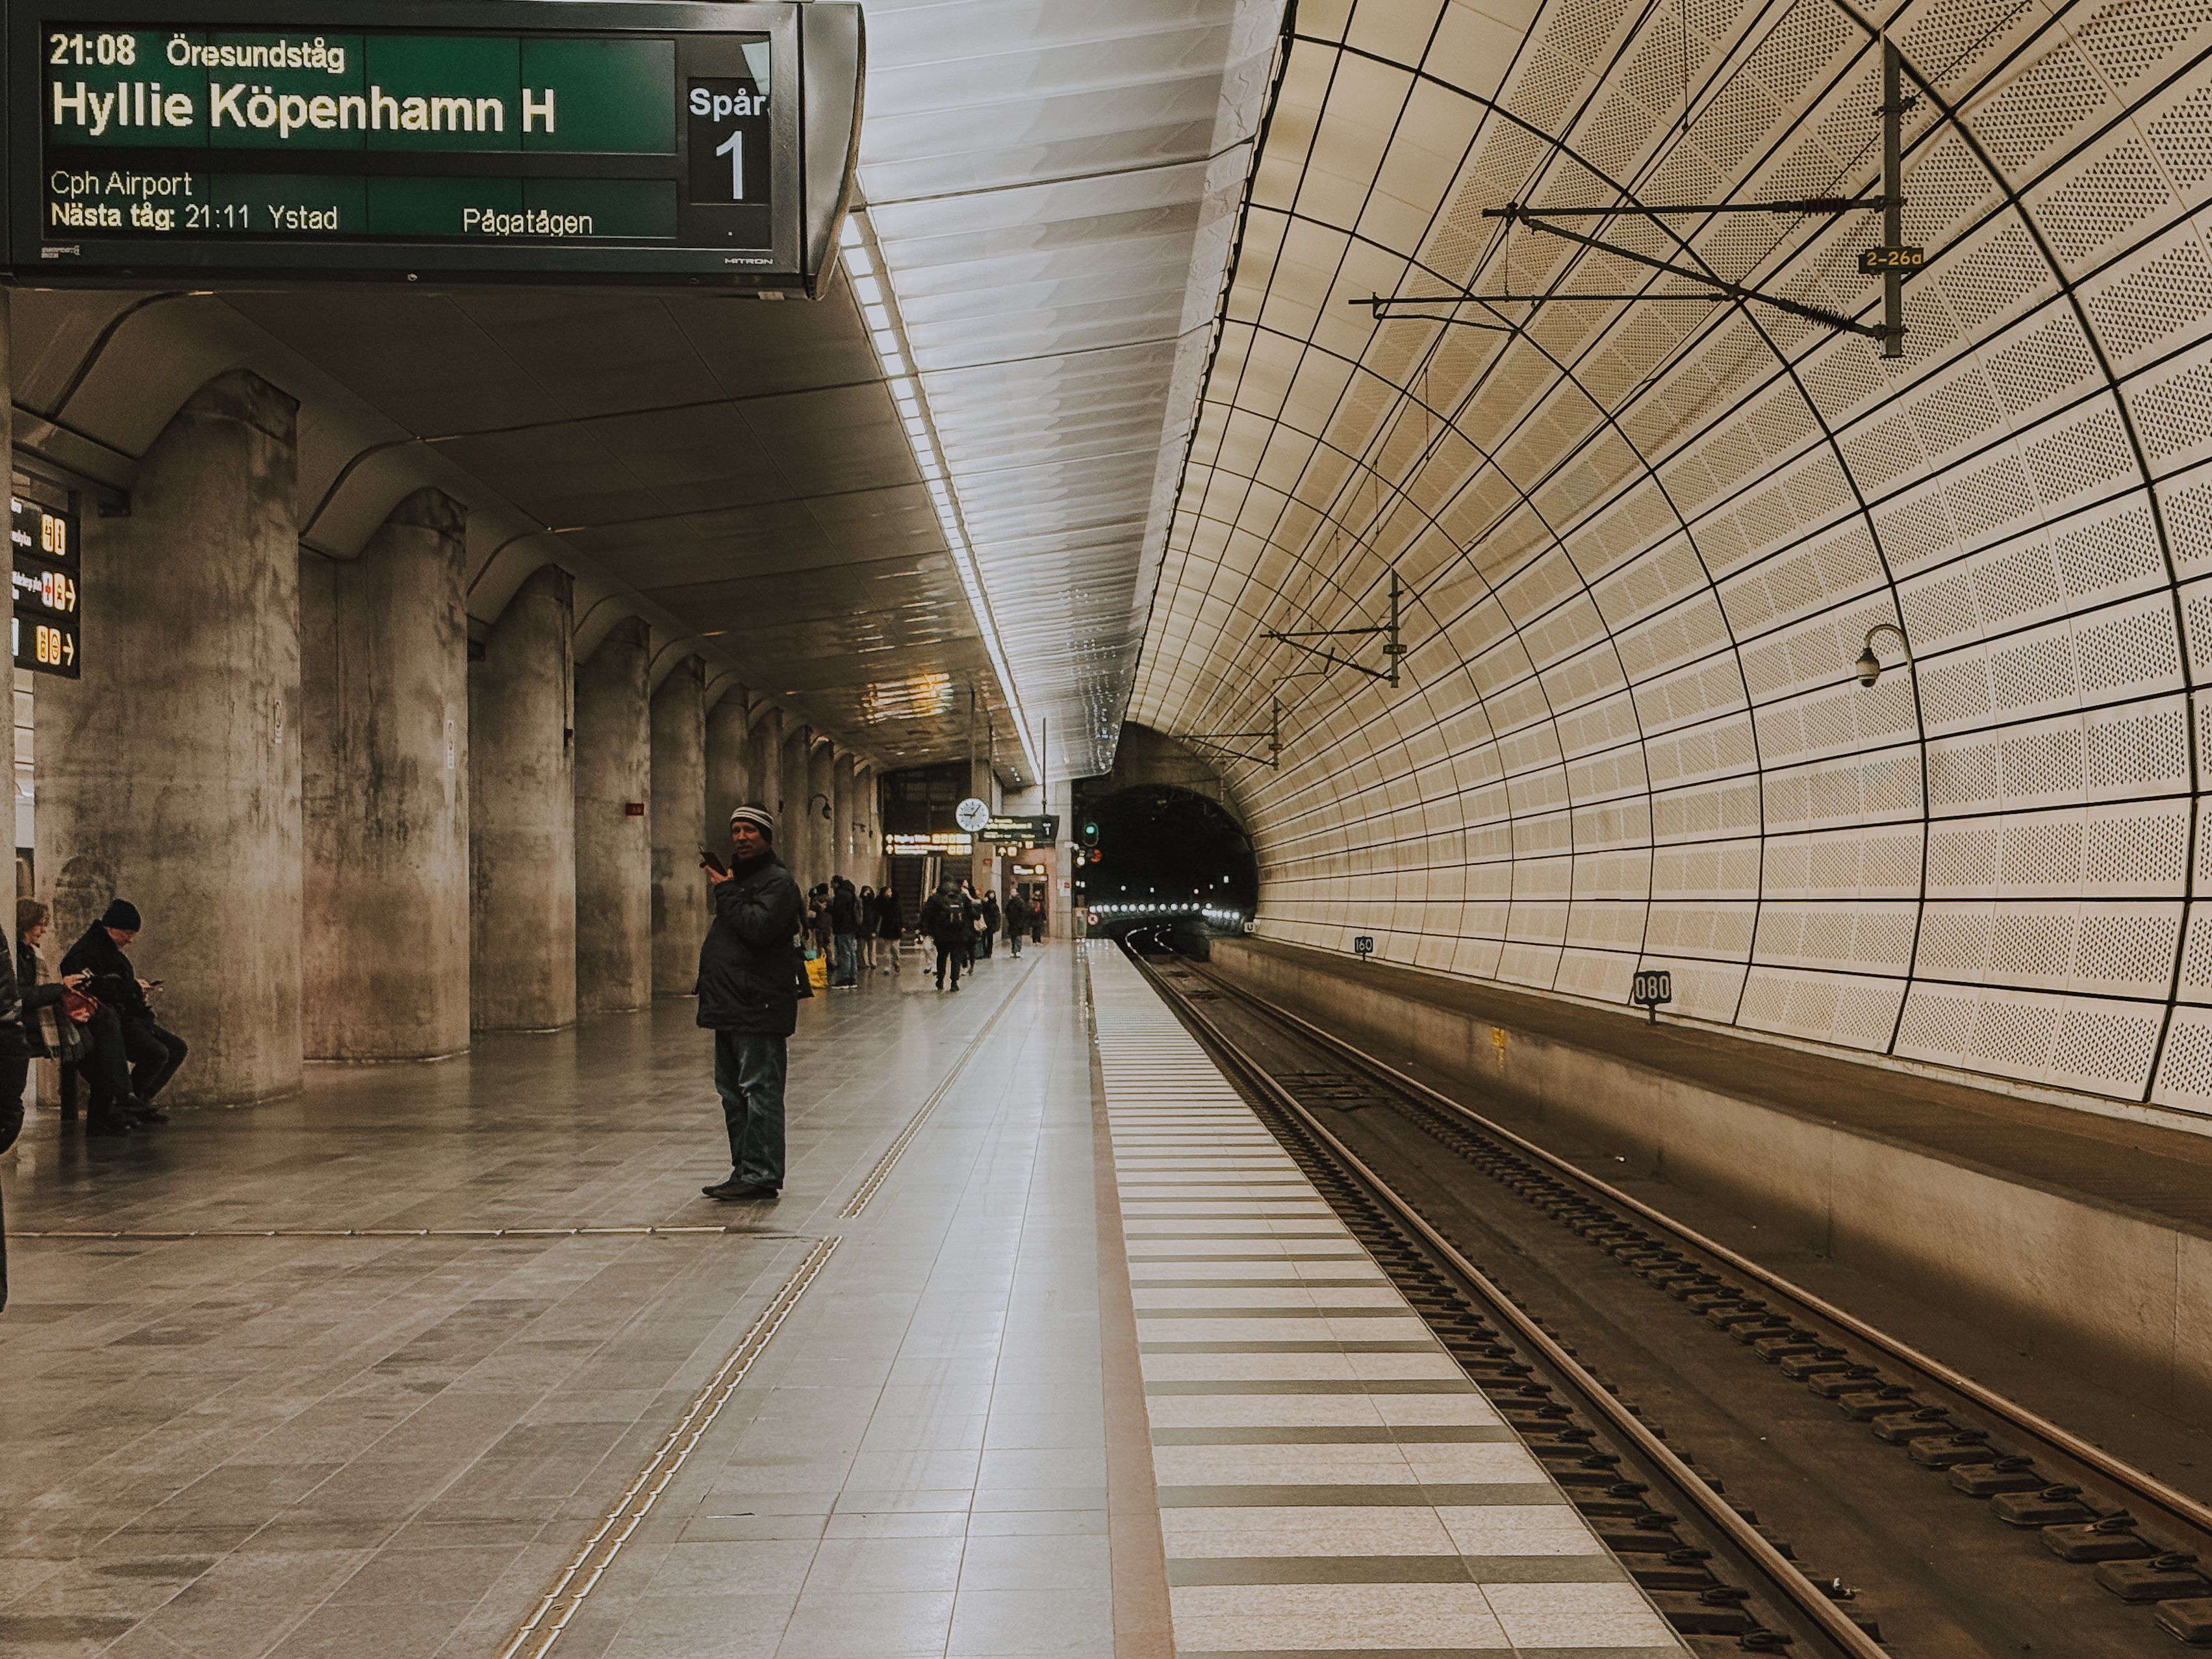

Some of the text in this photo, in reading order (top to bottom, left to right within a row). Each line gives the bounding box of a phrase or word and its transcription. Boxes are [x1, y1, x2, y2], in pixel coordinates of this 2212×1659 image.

[51, 34, 344, 73] 21:08 Öresundståg
[54, 82, 554, 138] Hyllie Köpenhamn H
[689, 88, 766, 122] Spår
[717, 131, 743, 199] 1
[52, 171, 192, 199] Cph Airport
[52, 202, 592, 236] Nästa tåg: 21:11 Ystad Pågatågen
[1866, 251, 1922, 266] 2-26a
[1356, 939, 1372, 951] 160
[1635, 975, 1670, 1000] 080
